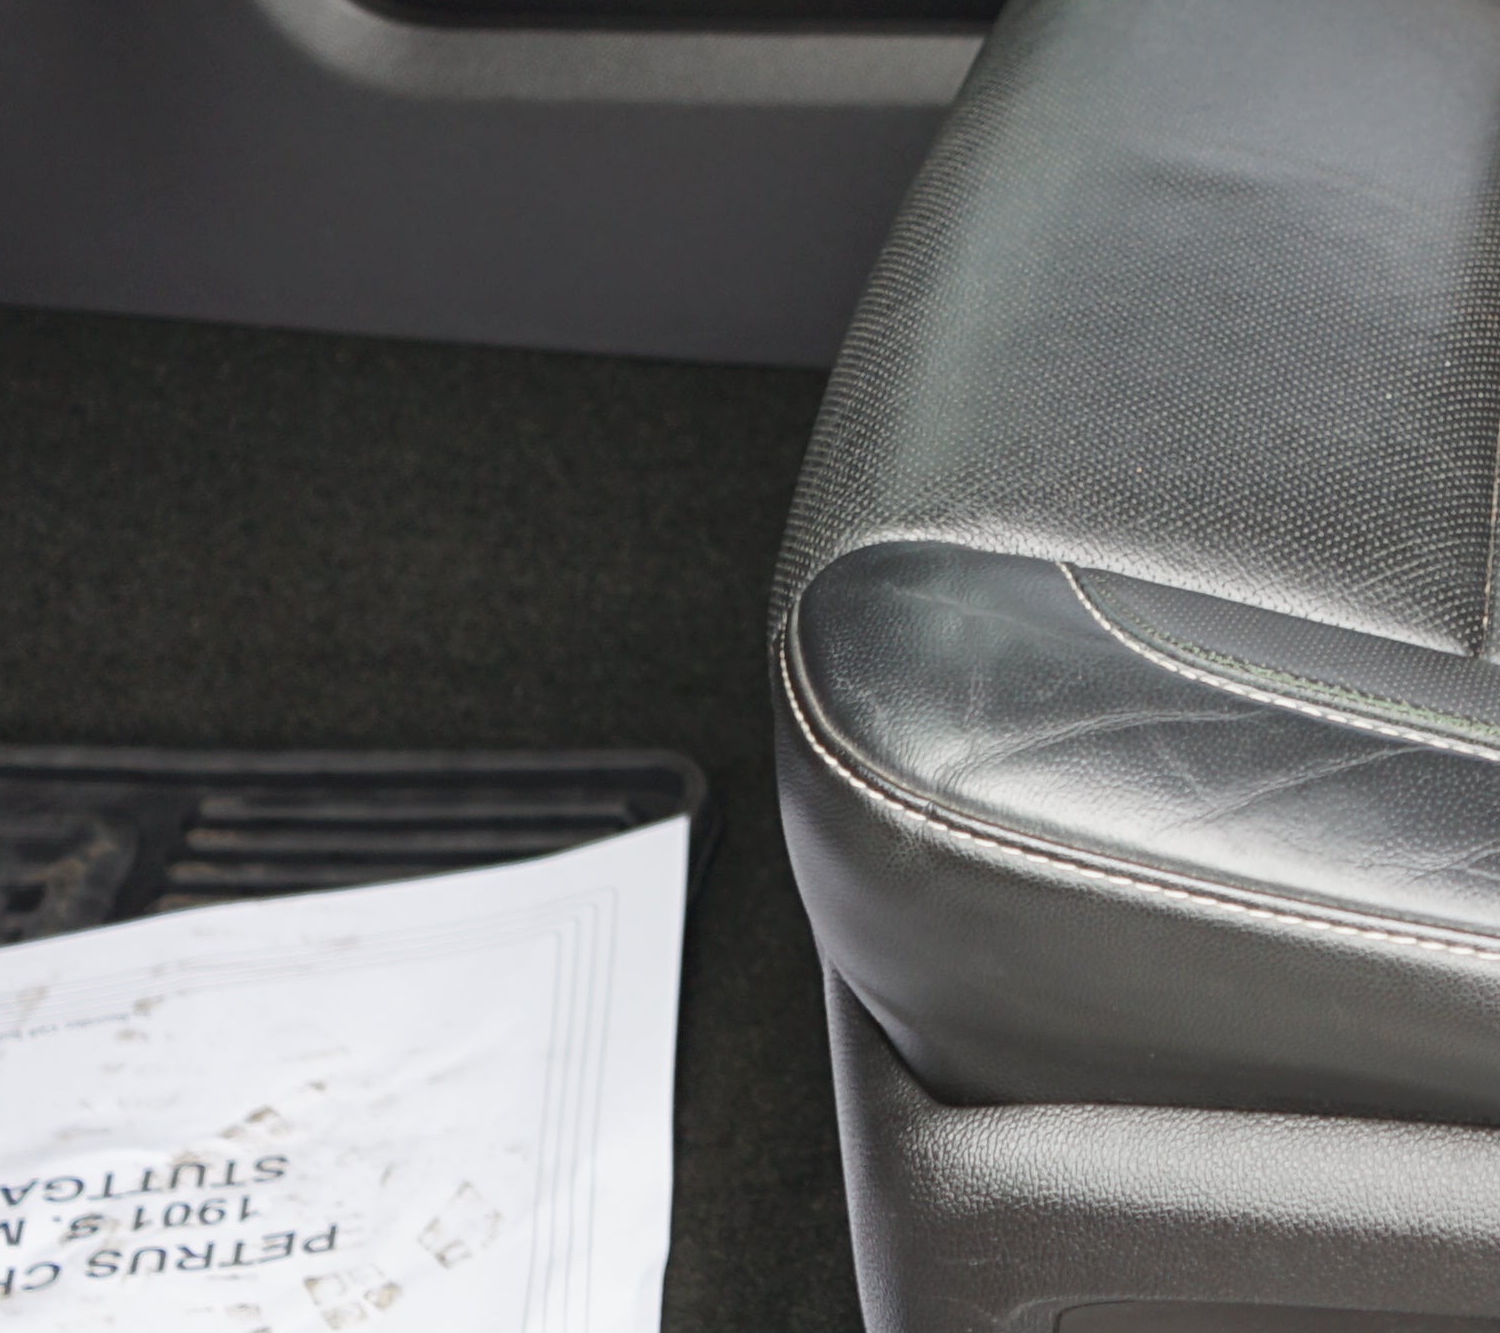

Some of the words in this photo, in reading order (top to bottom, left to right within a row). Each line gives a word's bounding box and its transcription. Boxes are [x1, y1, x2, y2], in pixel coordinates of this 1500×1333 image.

[52, 1212, 106, 1241] S.
[130, 1194, 259, 1231] 1901
[85, 1223, 339, 1280] PETRUS
